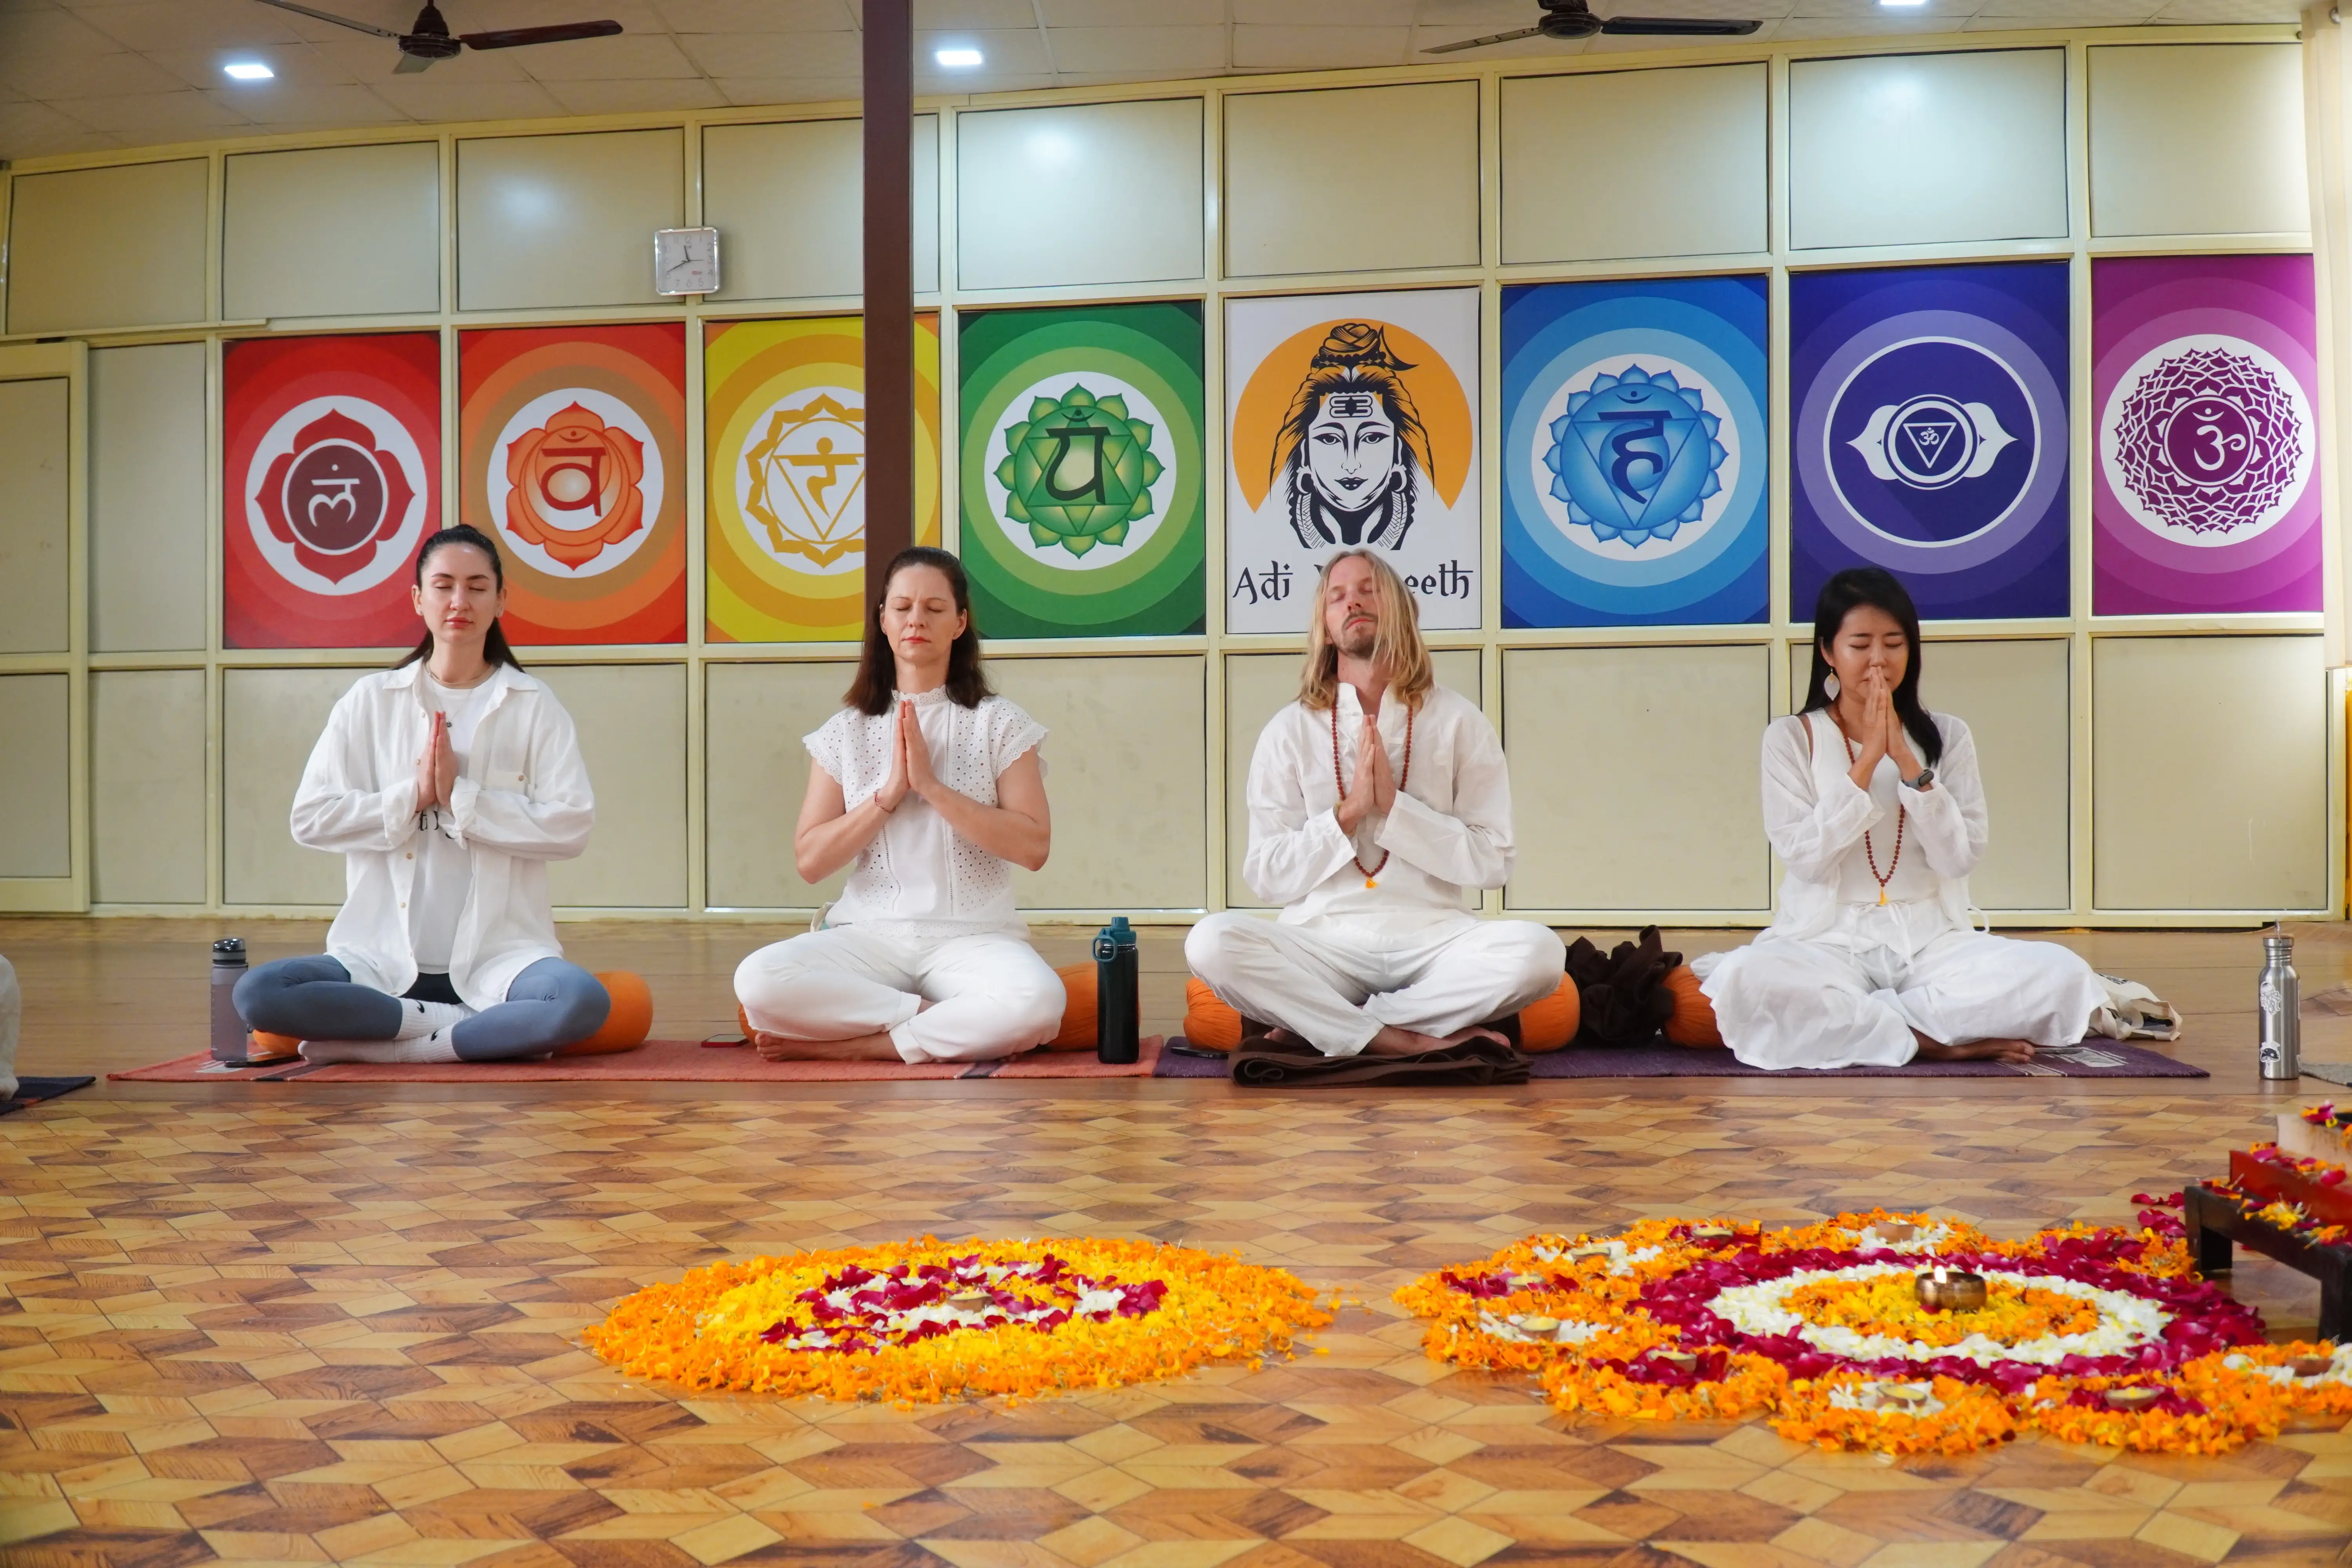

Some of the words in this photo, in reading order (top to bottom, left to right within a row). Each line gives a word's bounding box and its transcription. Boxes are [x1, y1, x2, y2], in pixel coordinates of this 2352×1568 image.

[707, 242, 712, 251] 2
[708, 255, 713, 264] 3
[675, 279, 680, 287] 7
[686, 278, 692, 287] 6
[698, 278, 704, 287] 5
[1918, 427, 1939, 446] ॐ
[1232, 560, 1294, 605] Adi
